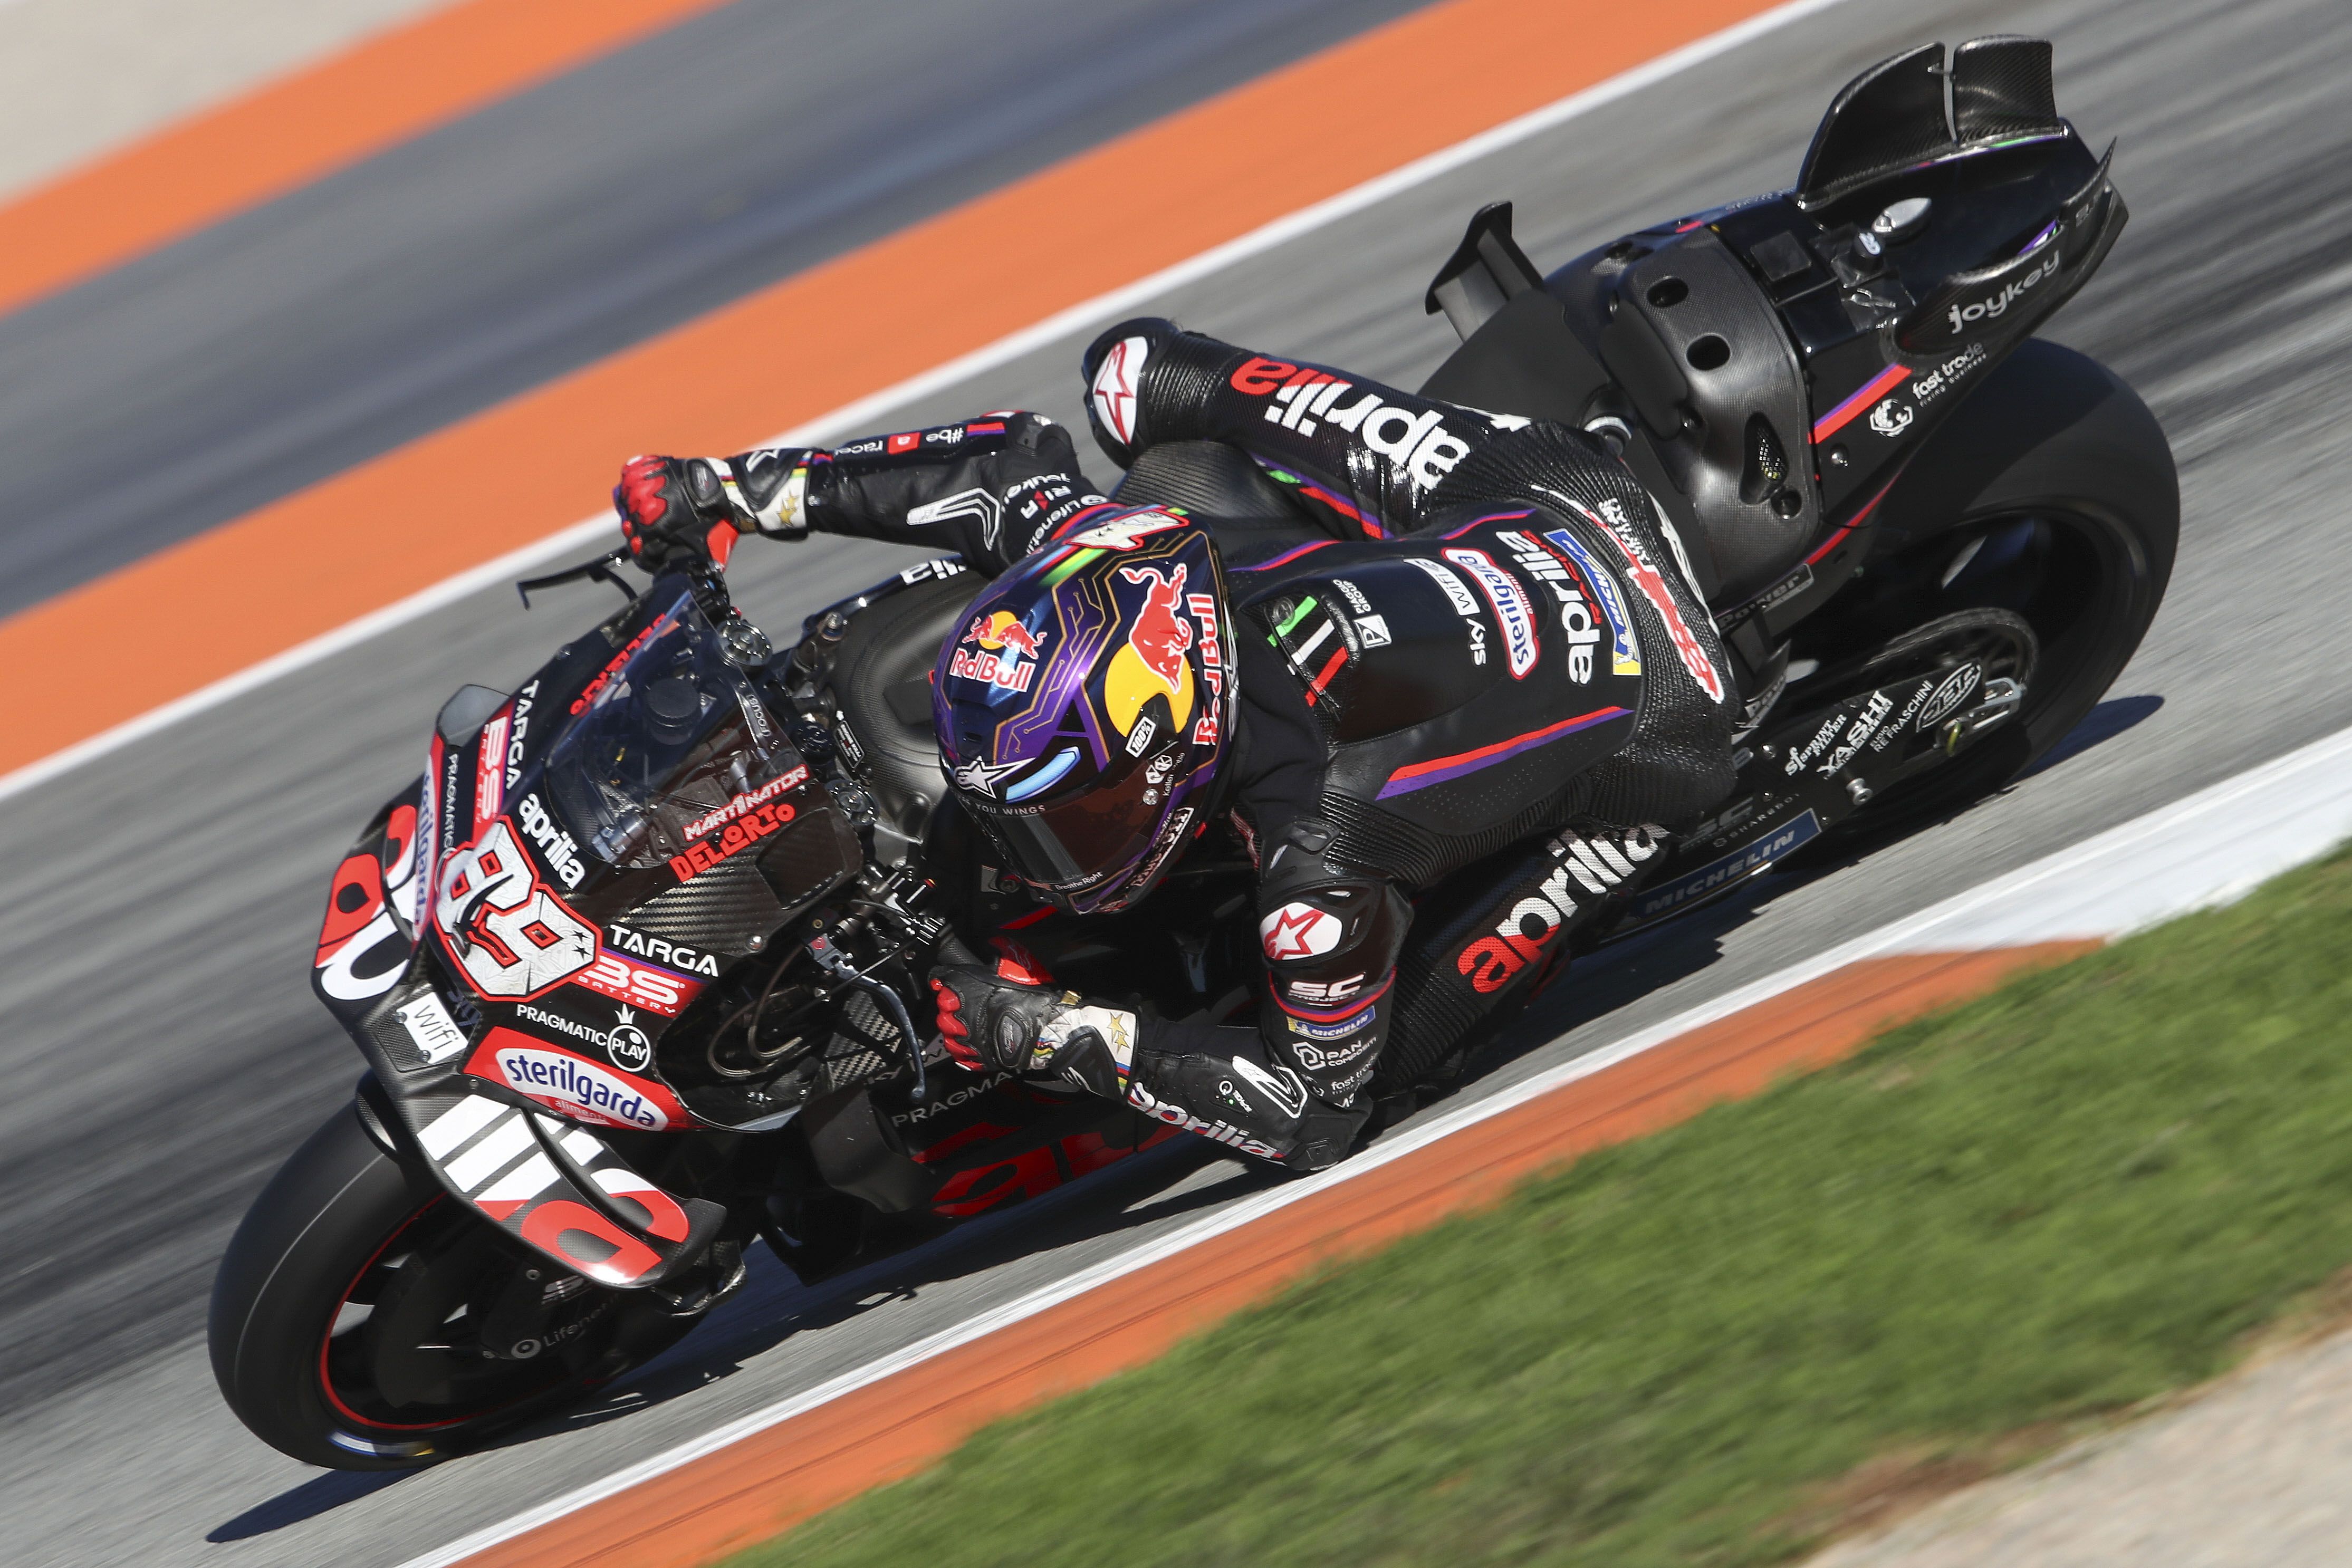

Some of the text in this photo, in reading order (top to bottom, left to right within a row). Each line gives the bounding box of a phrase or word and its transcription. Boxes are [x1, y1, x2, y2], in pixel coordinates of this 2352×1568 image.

[1947, 250, 2060, 334] joykey
[1913, 342, 1984, 401] fast trade
[926, 427, 964, 444] #be
[1231, 357, 1474, 492] aprilia
[1333, 579, 1362, 614] PIAGGIO
[1343, 580, 1371, 612] GROUP
[1520, 530, 1602, 625] RACING
[1186, 593, 1222, 667] Bull
[1495, 530, 1601, 686] aprilia
[1465, 617, 1486, 667] sky
[976, 653, 1036, 692] Bull
[507, 679, 540, 790] TARGA
[1131, 723, 1152, 753] 100%
[1799, 719, 1833, 763] SPRINT
[1813, 714, 1848, 758] FILTER
[1816, 689, 1888, 774] YASHI
[1873, 679, 1934, 754] RE FRASCHINI
[444, 753, 459, 850] PRAGMATIC
[976, 804, 1045, 815] YOU WINGS
[519, 793, 586, 890] aprilia
[1081, 870, 1104, 888] Right
[1645, 829, 1795, 914] MICHELIN
[1457, 823, 1671, 994] aprilia
[610, 925, 719, 977] TARGA
[578, 976, 677, 1015] BATTERY
[582, 955, 679, 1006] BS
[1288, 973, 1366, 998] SC
[414, 1004, 460, 1051] wifi
[516, 1004, 608, 1048] PRAGMATIC
[611, 1037, 647, 1061] PLAY
[1310, 1014, 1369, 1036] MICHELIN
[1326, 1040, 1362, 1060] PAN
[1328, 1036, 1377, 1067] COMPOSITI
[505, 1054, 657, 1128] sterilgarda
[891, 1067, 1022, 1128] PRAGMA
[1330, 1075, 1356, 1091] fast
[1127, 1081, 1288, 1165] aprilia
